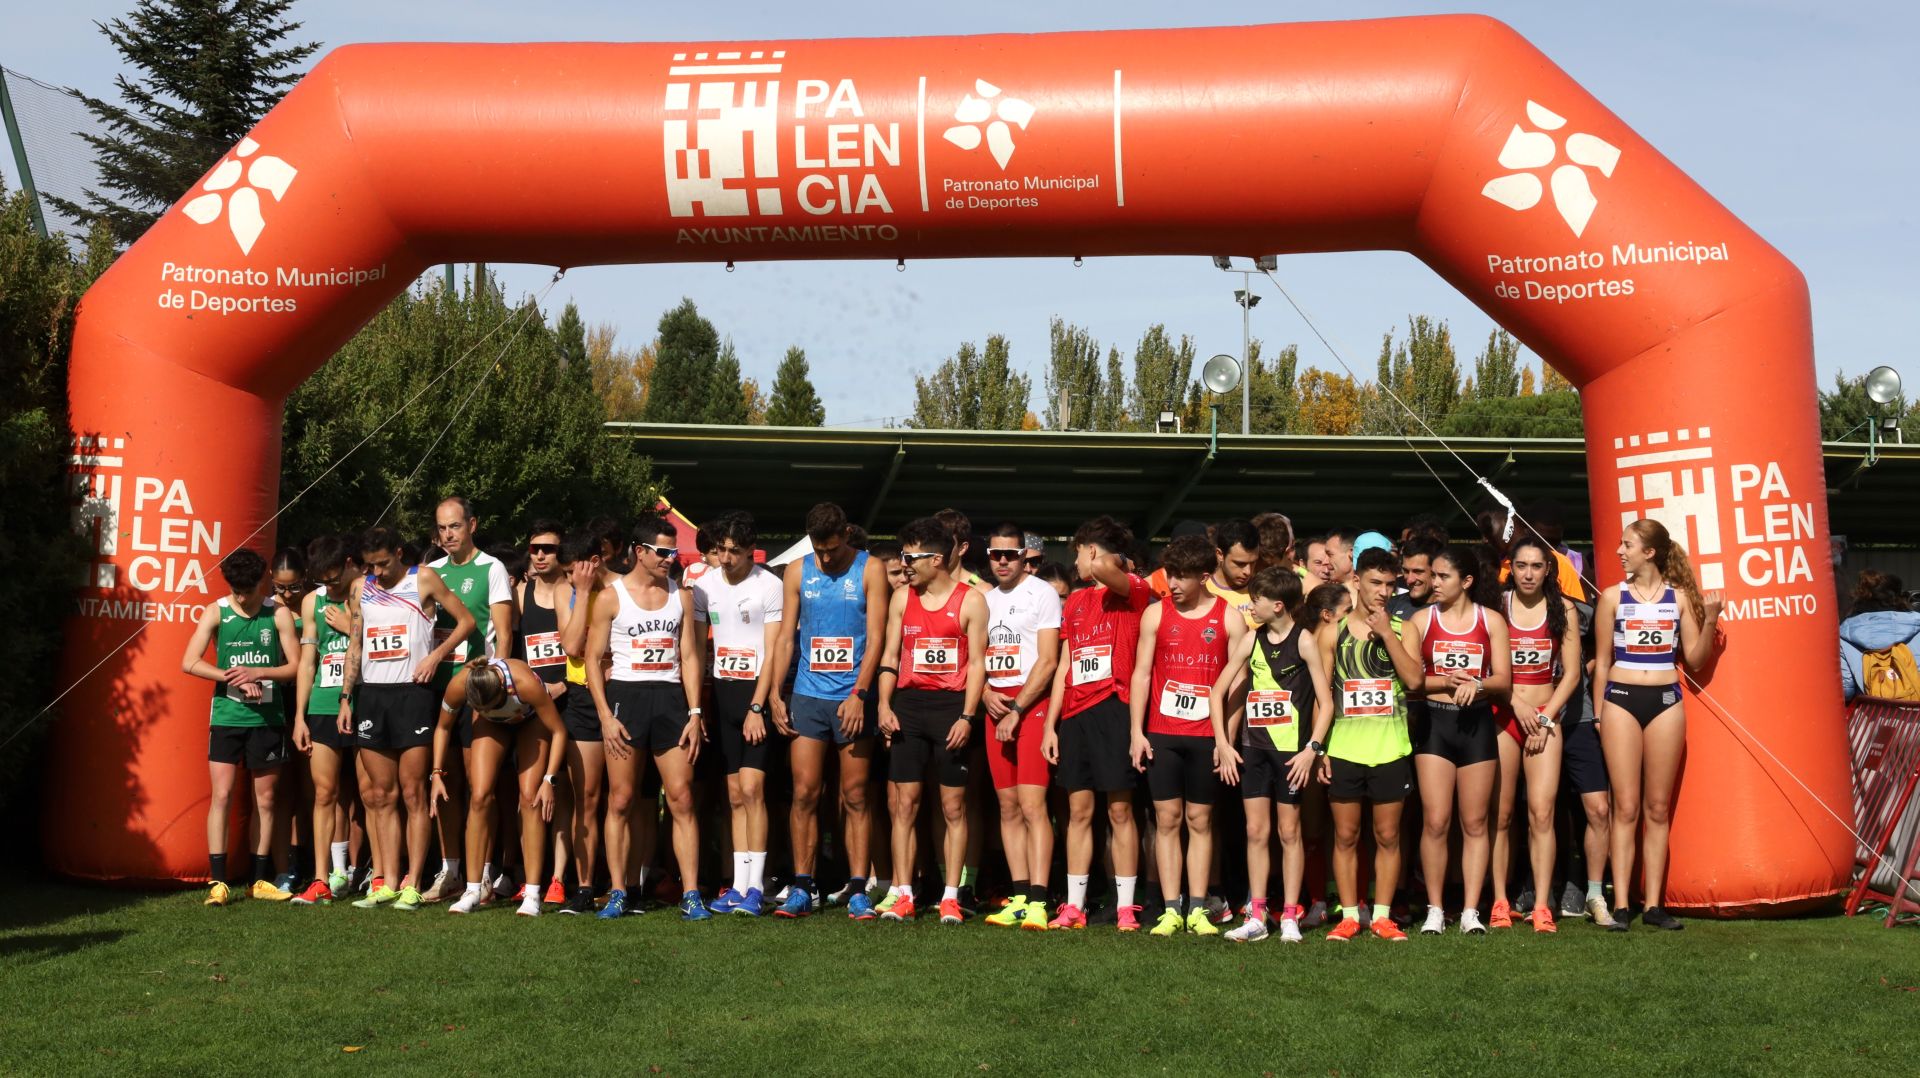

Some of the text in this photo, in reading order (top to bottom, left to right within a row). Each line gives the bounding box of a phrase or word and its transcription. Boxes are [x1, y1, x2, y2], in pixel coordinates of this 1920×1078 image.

[796, 79, 865, 118] PA
[796, 123, 900, 168] LEN
[943, 174, 1099, 192] Patronato Municipal
[797, 174, 894, 214] CIA
[946, 195, 1038, 211] de Deportes
[676, 224, 898, 245] AYUNTAMIENTO
[1487, 241, 1729, 273] Patronato Municipal
[161, 262, 386, 286] Patronato Municipal
[1494, 278, 1635, 304] de Deportes
[158, 289, 297, 315] de Deportes
[1731, 461, 1791, 502] PA
[134, 476, 194, 515] PA
[1734, 502, 1815, 544] LEN
[131, 516, 222, 556] LEN
[128, 555, 209, 594] CIA
[1738, 545, 1814, 587] CIA
[371, 635, 403, 651] 115
[1638, 630, 1663, 645] 26
[229, 650, 270, 668] gullón
[532, 643, 564, 658] 151
[643, 649, 665, 662] 27
[815, 648, 848, 663] 102
[925, 649, 947, 664] 68
[1514, 651, 1540, 664] 52
[720, 657, 750, 671] 175
[989, 655, 1015, 670] 170
[1079, 657, 1099, 673] 706
[1445, 653, 1470, 668] 53
[329, 663, 344, 677] 79
[1175, 694, 1197, 710] 707
[1350, 691, 1387, 706] 133
[1252, 702, 1285, 717] 158
